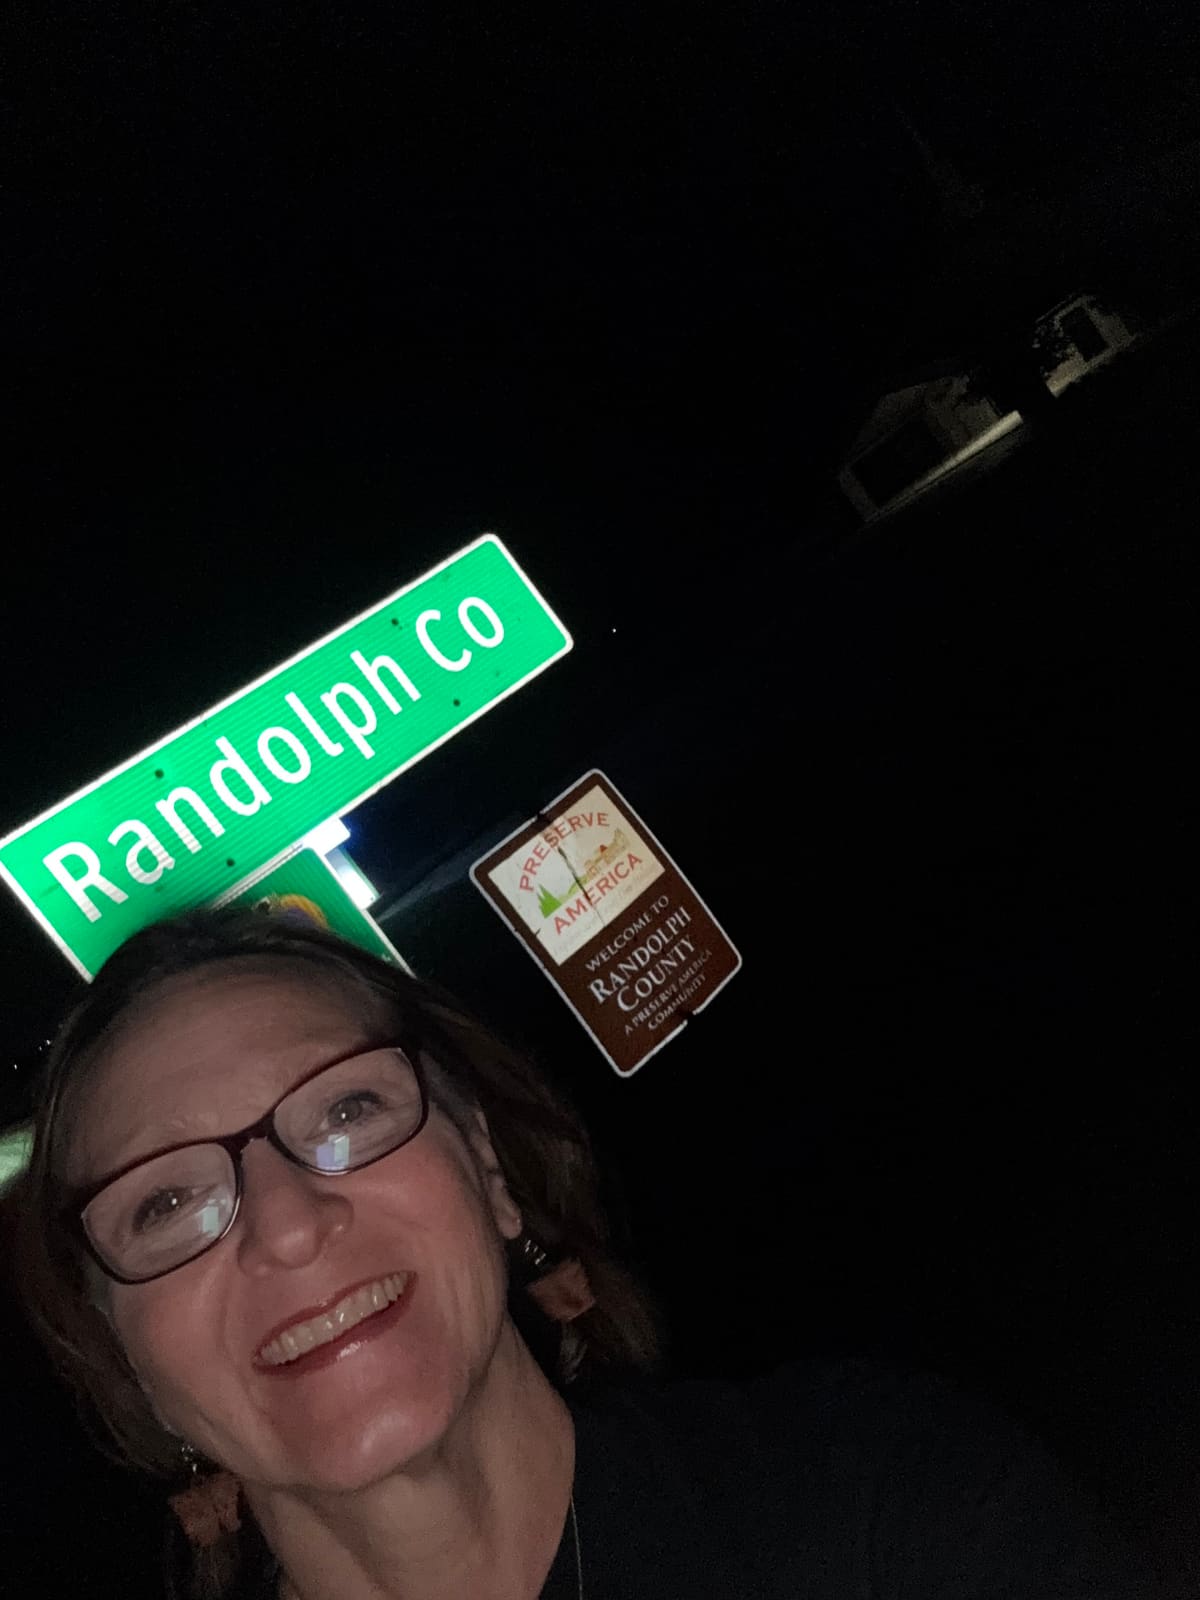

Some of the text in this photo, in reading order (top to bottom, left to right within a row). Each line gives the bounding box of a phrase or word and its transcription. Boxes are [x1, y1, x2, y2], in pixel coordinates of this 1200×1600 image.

[41, 649, 422, 924] Randolph
[414, 595, 505, 673] Co
[519, 812, 610, 893] PRESERVE
[553, 852, 643, 935] AMERICA
[586, 913, 651, 972] WELCOME
[650, 895, 669, 917] TO
[588, 906, 692, 1004] RANDOLPH
[617, 935, 696, 1012] COUNTY
[632, 986, 679, 1026] PRESERVE
[677, 950, 712, 991] AMERICA
[647, 973, 706, 1030] COMMUNITY
